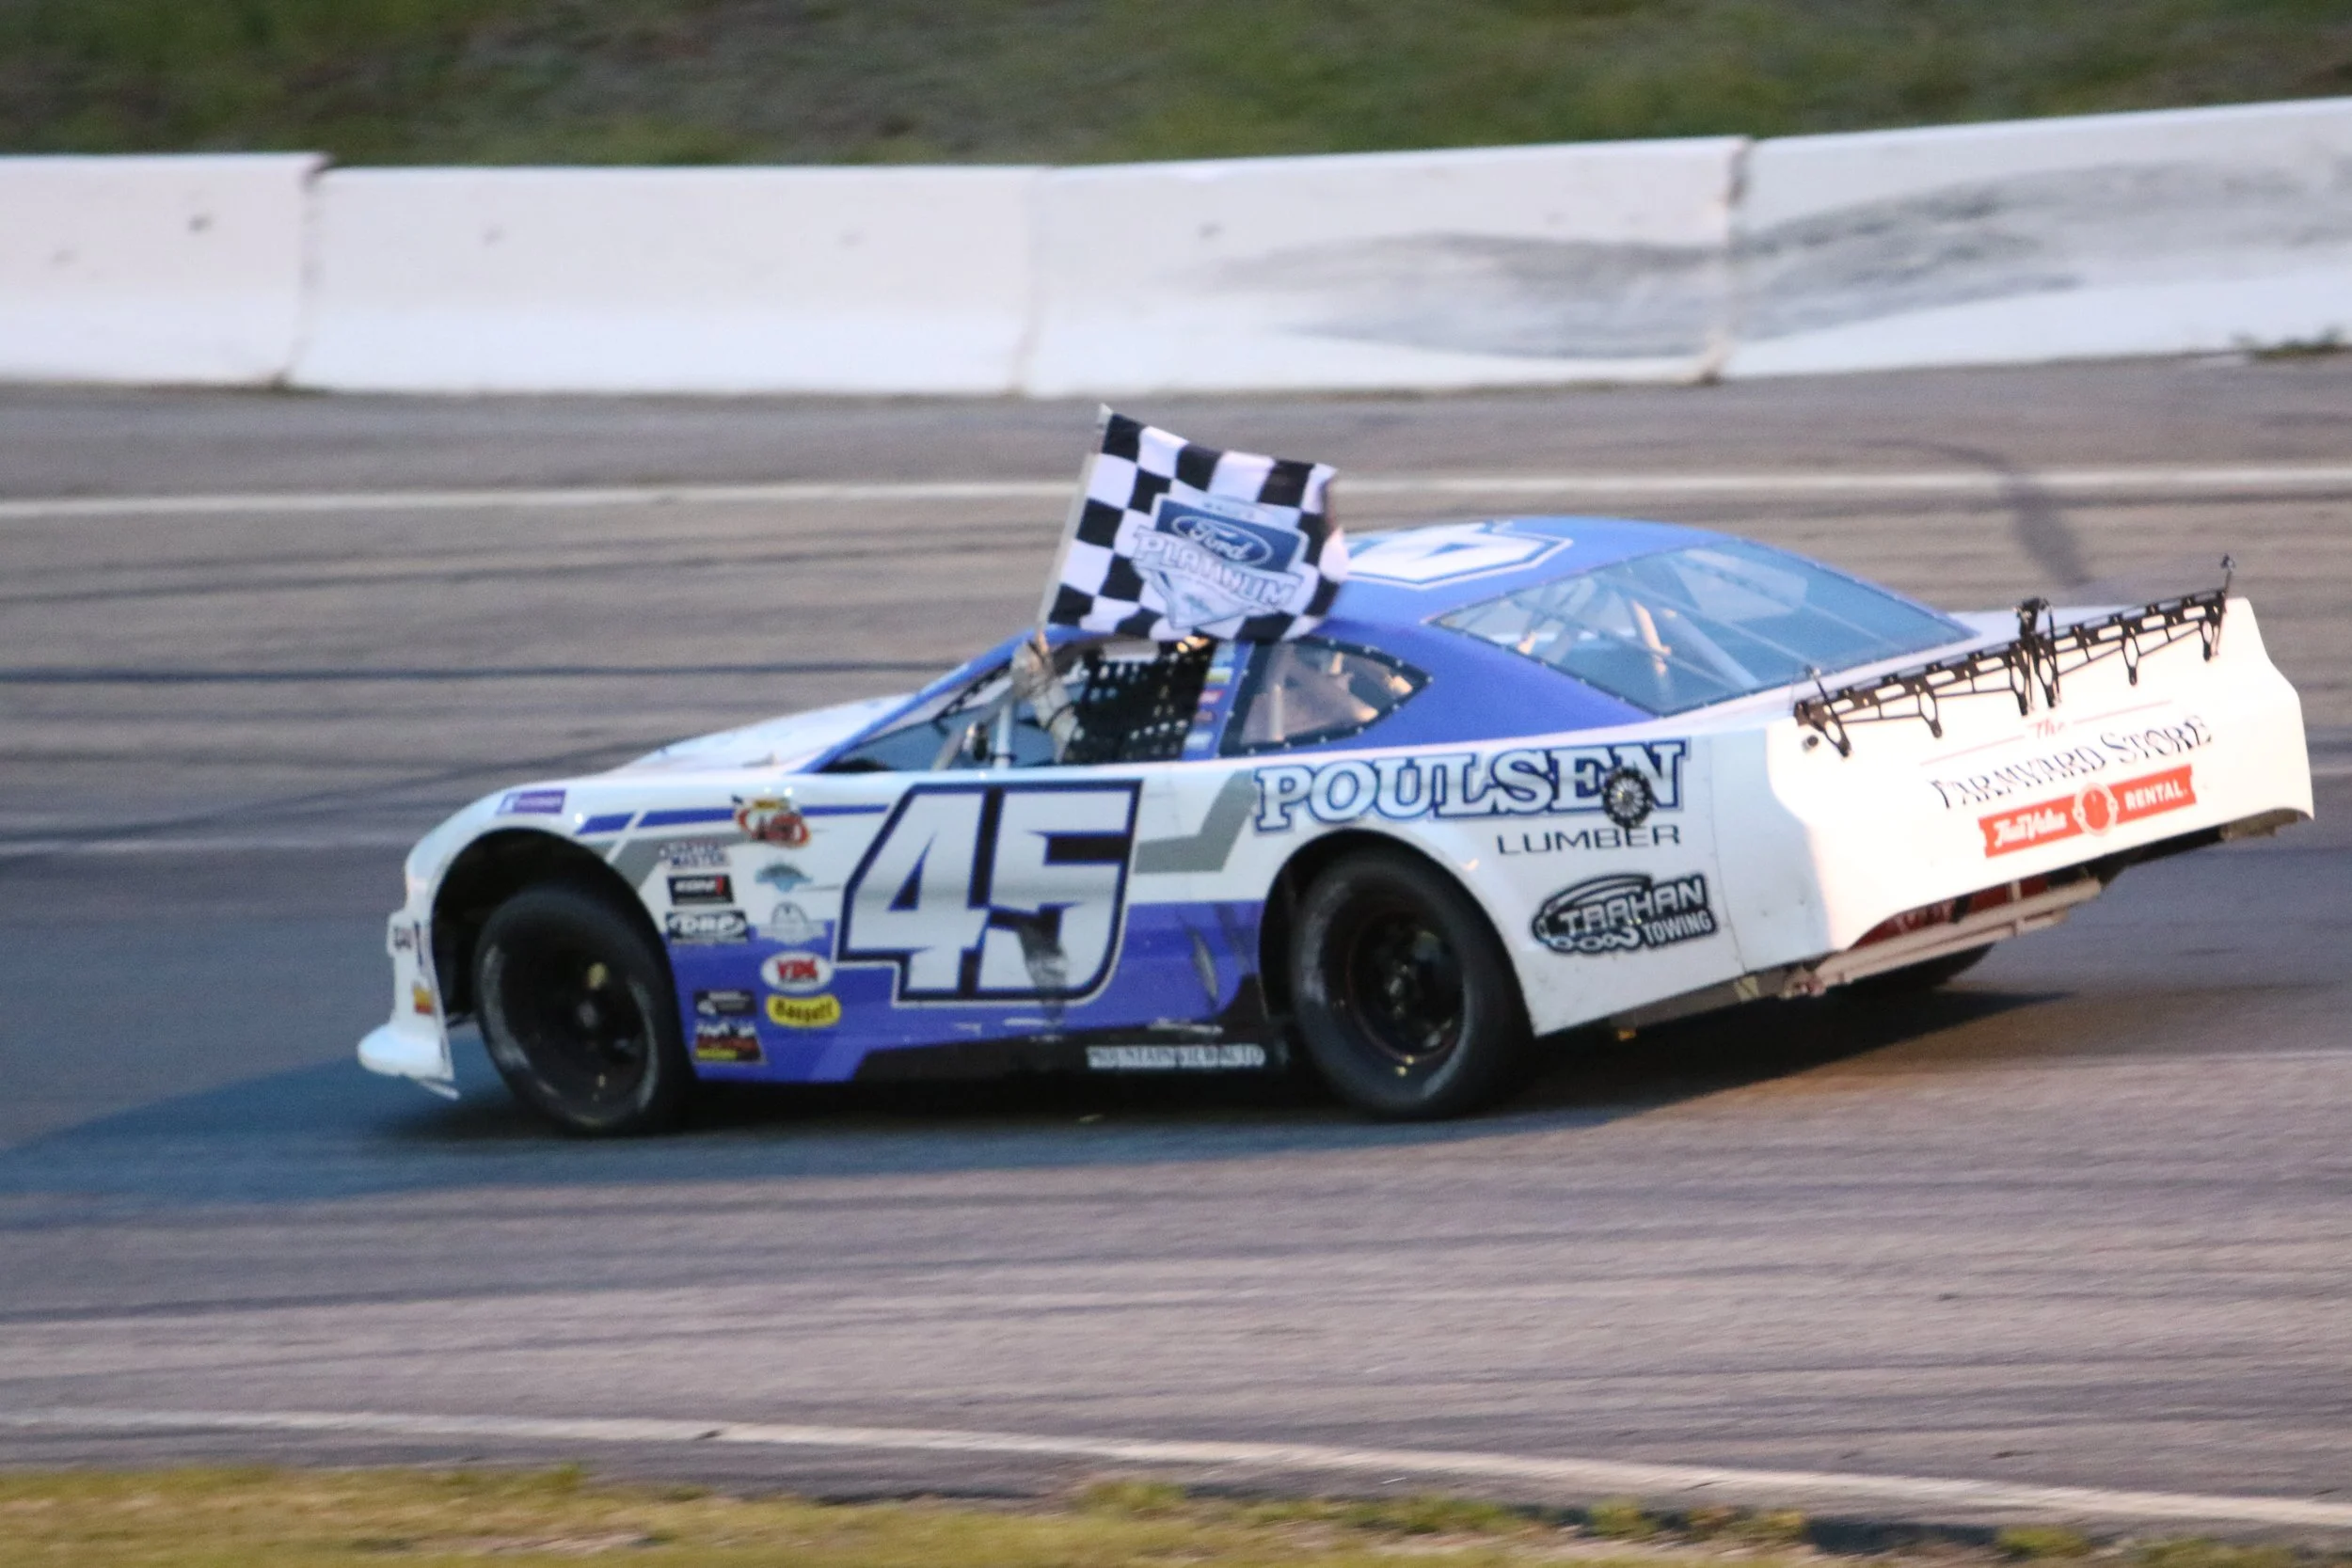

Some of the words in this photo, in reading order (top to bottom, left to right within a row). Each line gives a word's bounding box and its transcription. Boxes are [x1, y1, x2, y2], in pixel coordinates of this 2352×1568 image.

[1189, 519, 1254, 561] Ford
[1132, 525, 1305, 607] PLATINUM
[2026, 719, 2066, 739] The
[2100, 715, 2212, 764] STORE
[1254, 739, 1689, 832] POULSEN
[2123, 779, 2184, 812] RENTAL
[1497, 825, 1681, 855] LUMBER
[837, 779, 1142, 1005] 45
[1558, 878, 1706, 933] TRAHAN
[1641, 909, 1712, 944] TOWING
